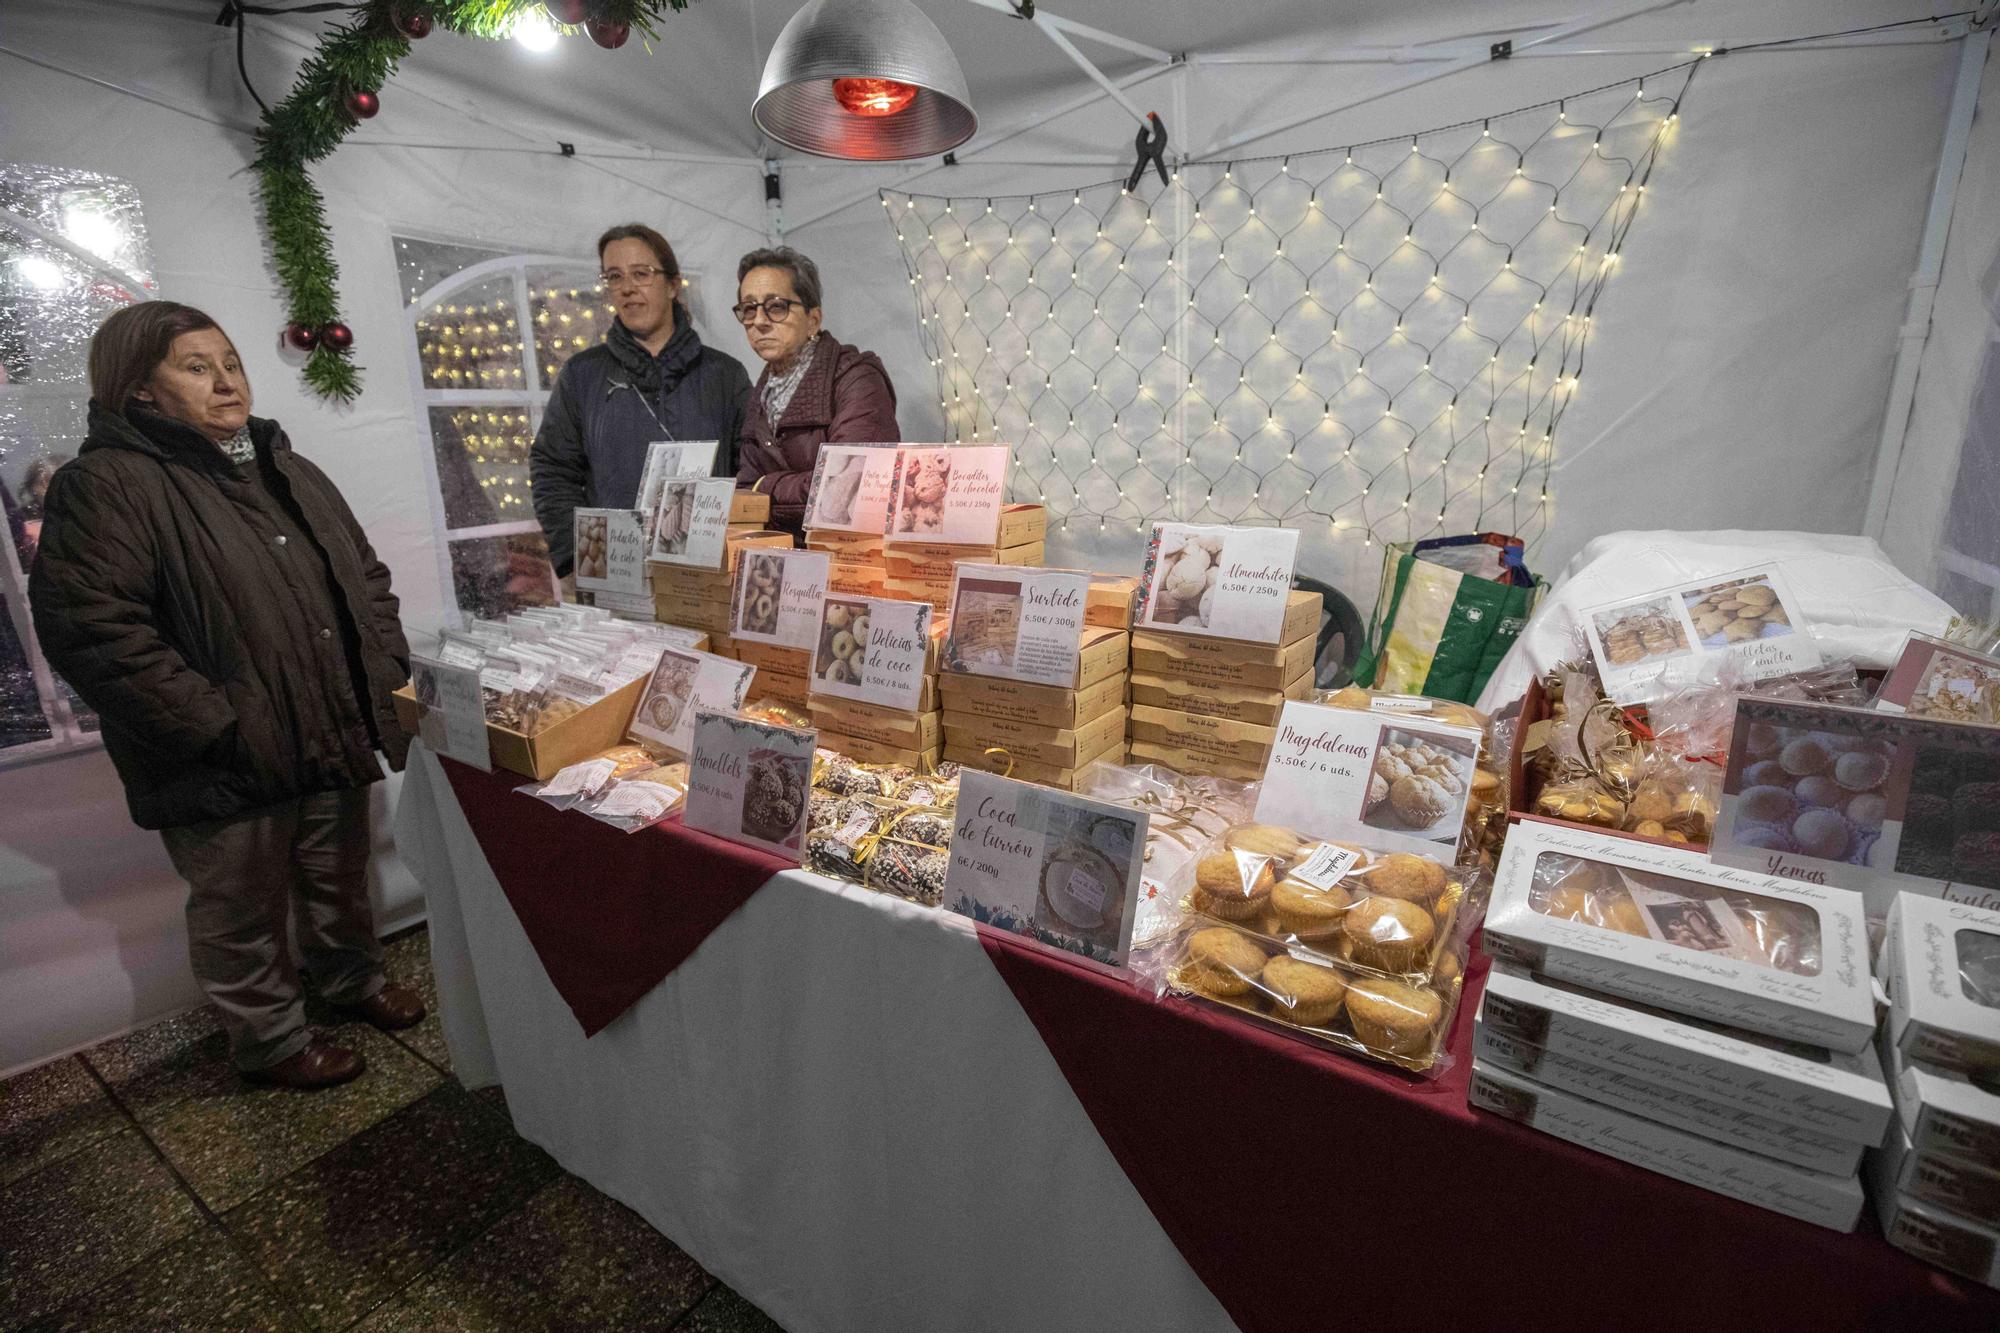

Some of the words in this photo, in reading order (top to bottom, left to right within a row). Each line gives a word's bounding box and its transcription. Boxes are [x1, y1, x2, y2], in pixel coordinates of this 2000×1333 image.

[953, 469, 989, 481] Bocaditos
[951, 482, 959, 492] de
[963, 482, 999, 494] chocolate
[1223, 563, 1289, 583] Almendritos
[1028, 585, 1079, 608] Surtido
[1248, 585, 1254, 594] /
[1256, 586, 1278, 597] 250g
[1048, 617, 1053, 625] /
[1055, 617, 1075, 628] 300g
[872, 627, 912, 652] Delicias
[869, 649, 881, 667] de
[887, 660, 912, 672] coco
[1280, 725, 1370, 759] Magdalenas
[694, 746, 741, 779] Panellets
[1309, 761, 1316, 771] /
[1320, 763, 1327, 772] 6
[1330, 767, 1354, 778] uds.
[978, 796, 1016, 828] Coca
[958, 818, 976, 840] de
[981, 825, 1032, 858] turrón
[1534, 832, 1573, 849] Dulces
[1573, 842, 1589, 852] del
[1590, 846, 1651, 865] Monasterio
[1652, 858, 1666, 867] de
[1667, 860, 1706, 875] Santa
[1753, 878, 1828, 899] Magdalena
[1767, 855, 1828, 885] Yemas
